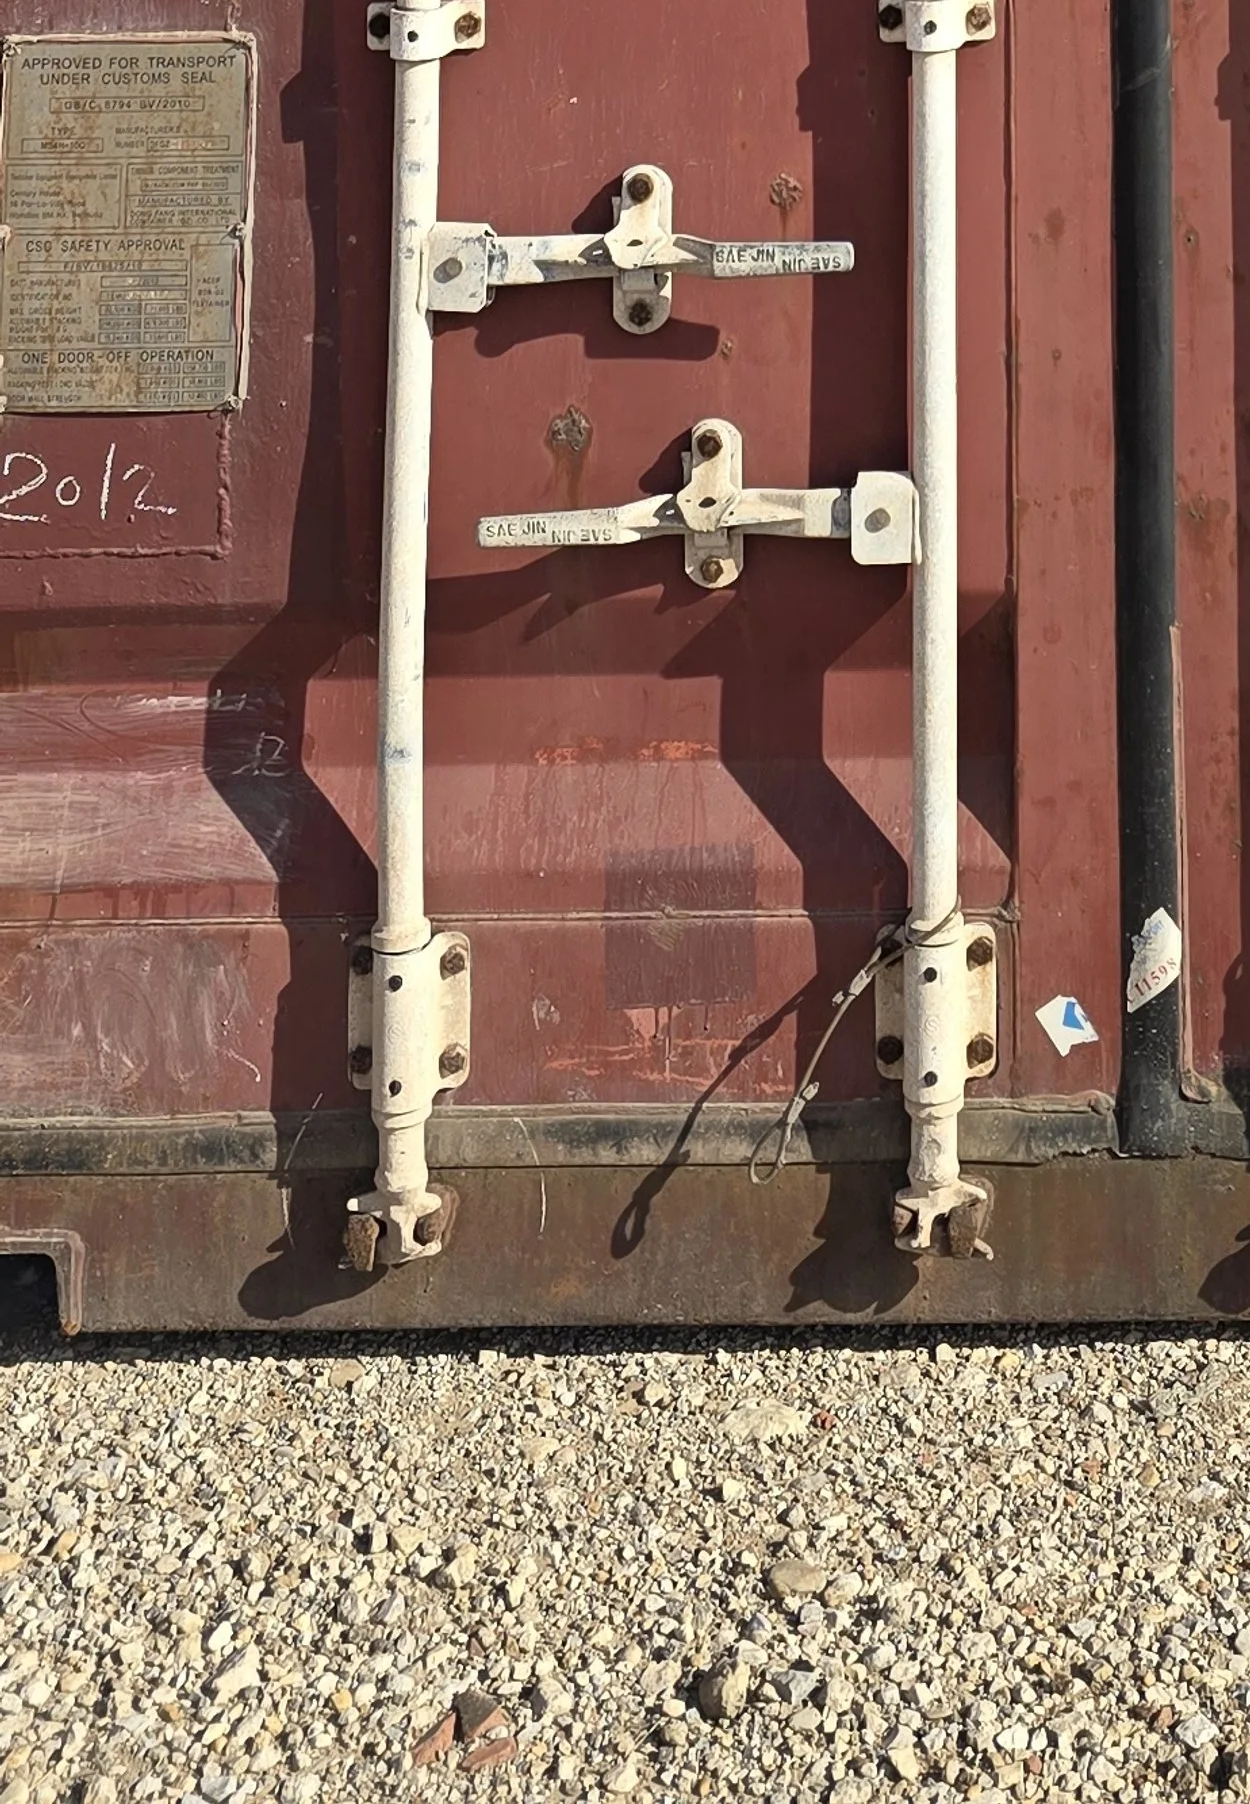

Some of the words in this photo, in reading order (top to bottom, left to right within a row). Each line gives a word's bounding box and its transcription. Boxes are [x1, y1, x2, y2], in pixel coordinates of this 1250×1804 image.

[21, 57, 102, 70] APPROVED
[109, 57, 139, 69] FOR
[149, 55, 236, 69] TRANSPORT
[40, 73, 91, 85] UNDER
[101, 72, 171, 84] CUSTOMS
[180, 71, 216, 84] SEAL
[61, 240, 111, 253] SAFETY
[118, 239, 186, 251] APPROVAL
[751, 247, 775, 262] JIN
[21, 352, 49, 364] ONE
[140, 349, 214, 362] OPERATION
[0, 443, 178, 523] 2012
[522, 521, 547, 535] JIN
